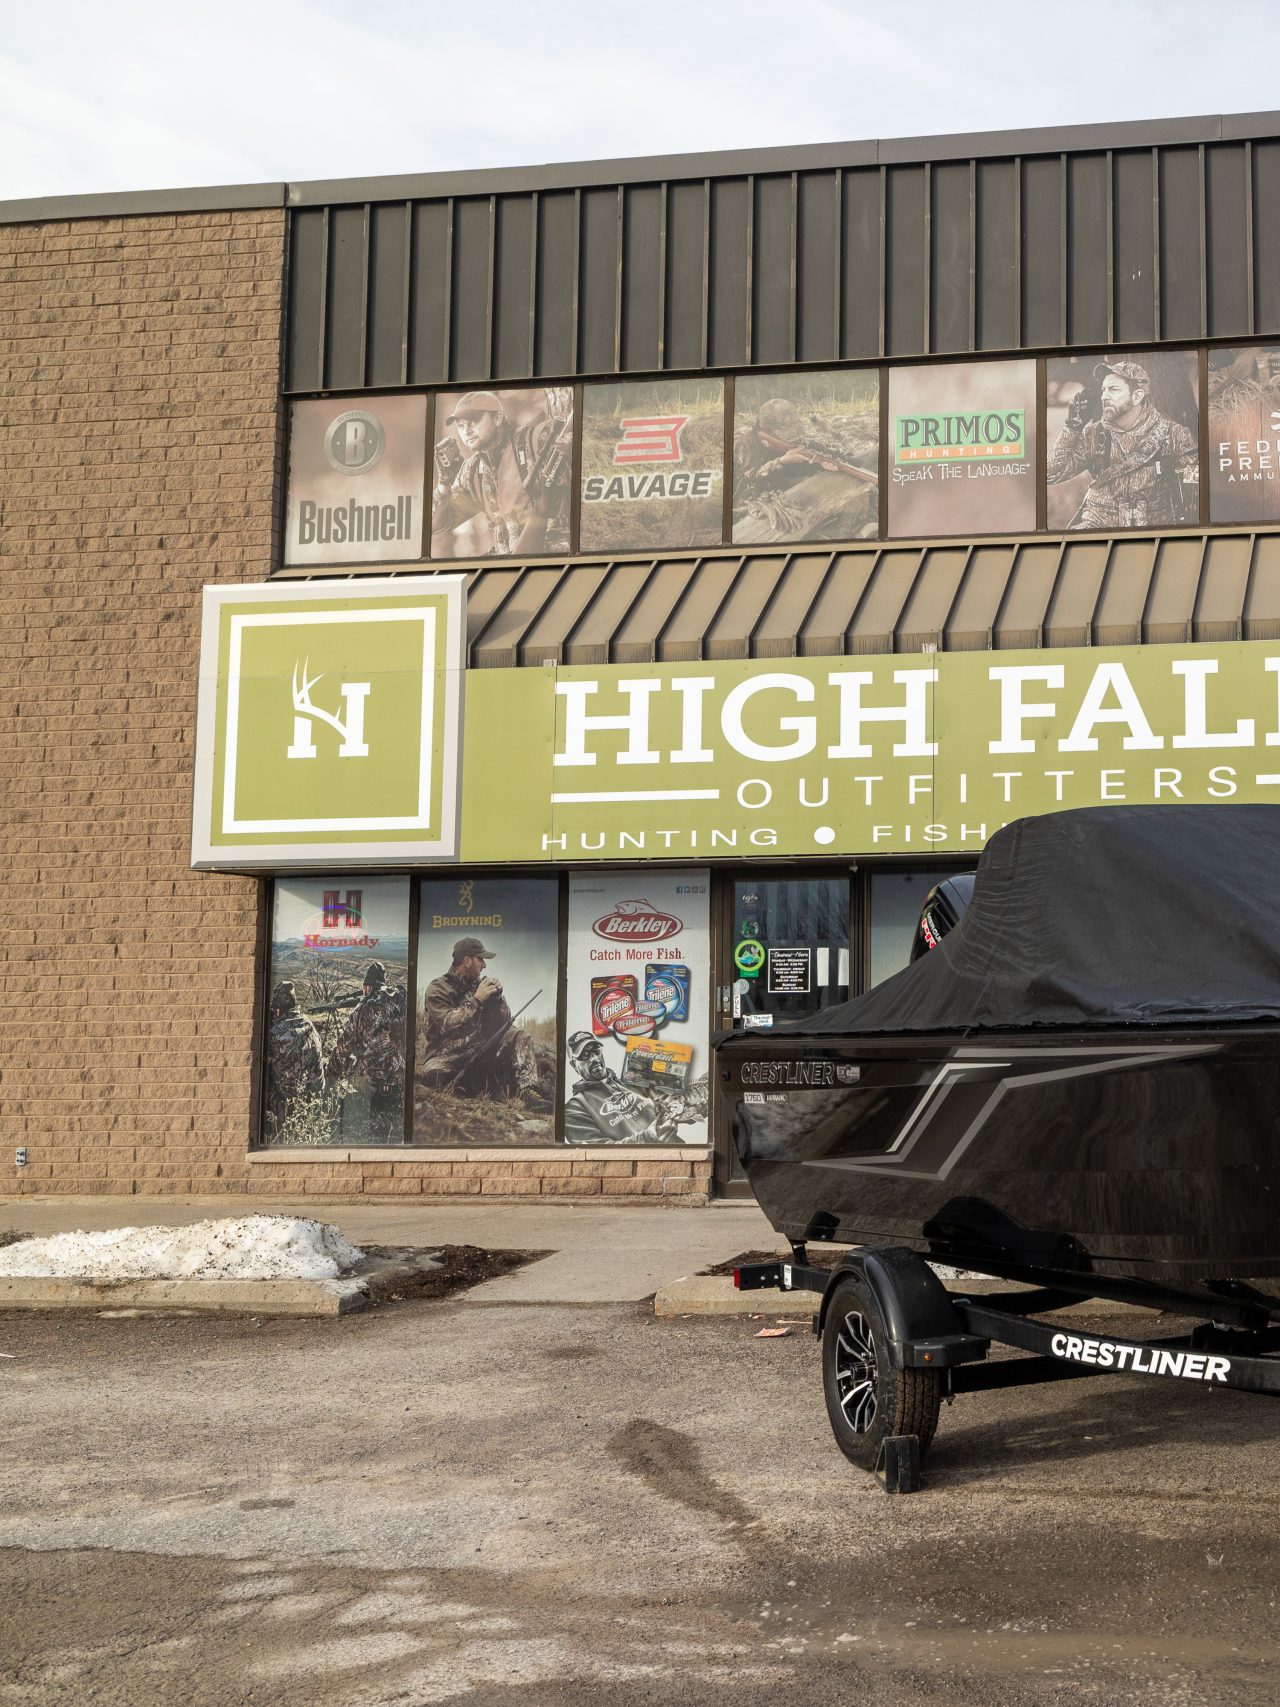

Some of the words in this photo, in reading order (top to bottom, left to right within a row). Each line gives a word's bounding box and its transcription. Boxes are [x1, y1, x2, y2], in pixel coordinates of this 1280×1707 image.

[900, 413, 1021, 448] PRIMOS
[910, 445, 1011, 459] HUNTING
[584, 472, 712, 501] SAVAGE
[298, 495, 412, 545] Bushnell
[552, 668, 940, 767] HIGH
[736, 765, 1238, 809] OUTFITTERS
[541, 827, 778, 851] HUNTING
[872, 822, 1008, 843] FISH
[432, 914, 503, 929] BROWNING
[604, 917, 673, 939] Berkley
[303, 934, 380, 949] Hornady
[590, 949, 621, 961] Catch
[626, 949, 653, 960] More
[647, 986, 676, 1003] Trilene
[601, 996, 632, 1022] Trilene
[740, 1061, 834, 1085] CRESTLINER
[1051, 1333, 1231, 1382] CRESTLINER
